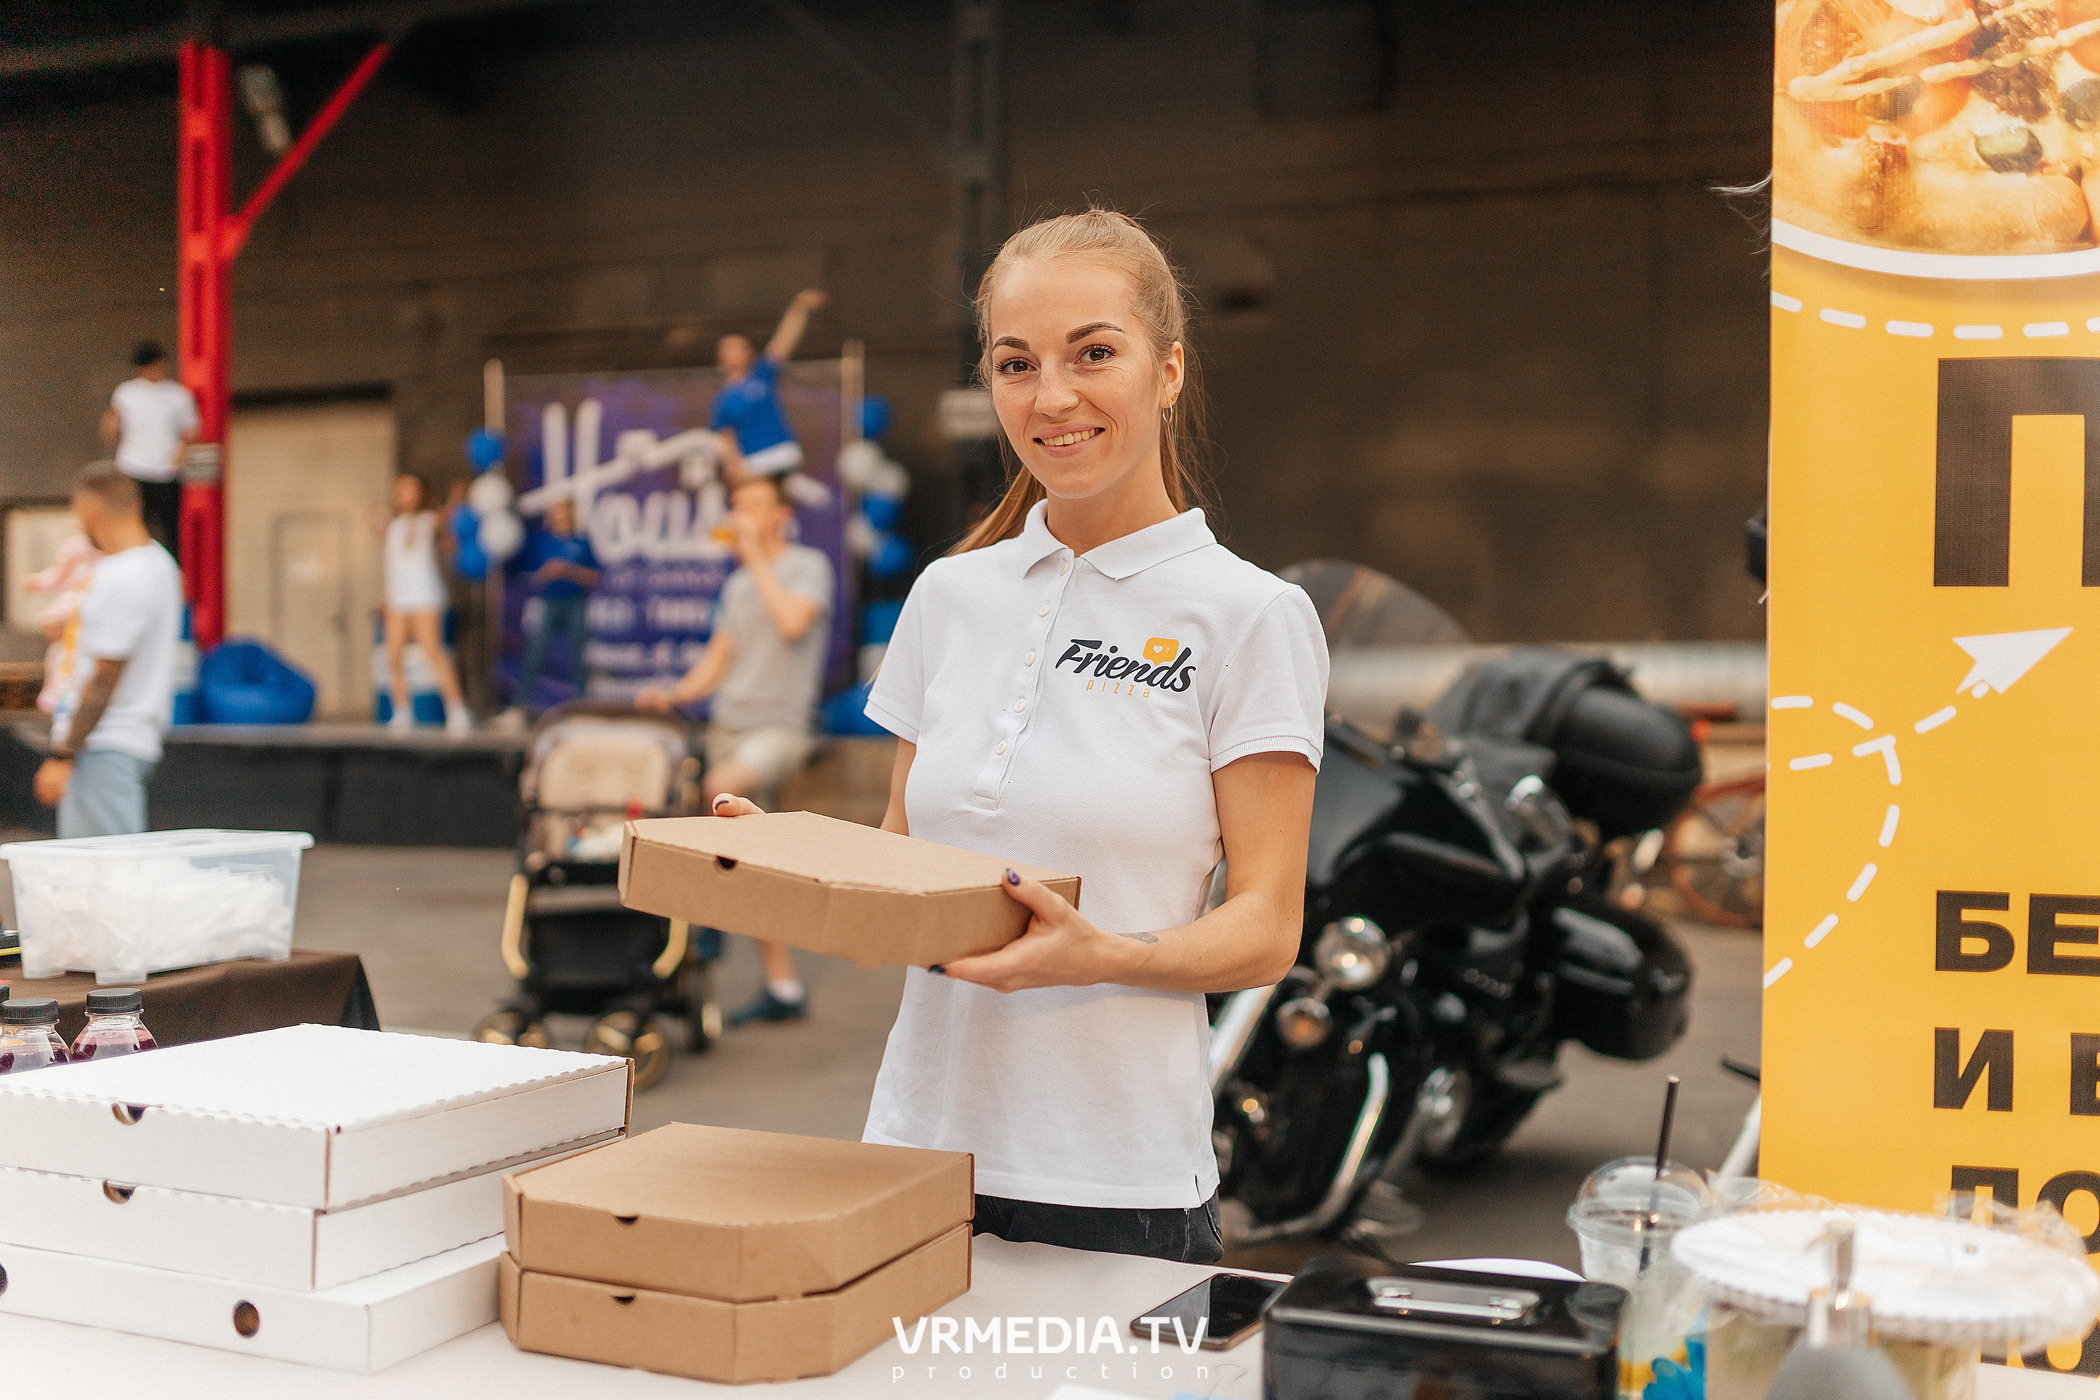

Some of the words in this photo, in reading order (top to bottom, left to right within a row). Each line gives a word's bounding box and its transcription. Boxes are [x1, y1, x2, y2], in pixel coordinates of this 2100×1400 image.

[1055, 638, 1197, 693] Friends
[1085, 678, 1151, 698] pizza
[1933, 1026, 2015, 1113] И
